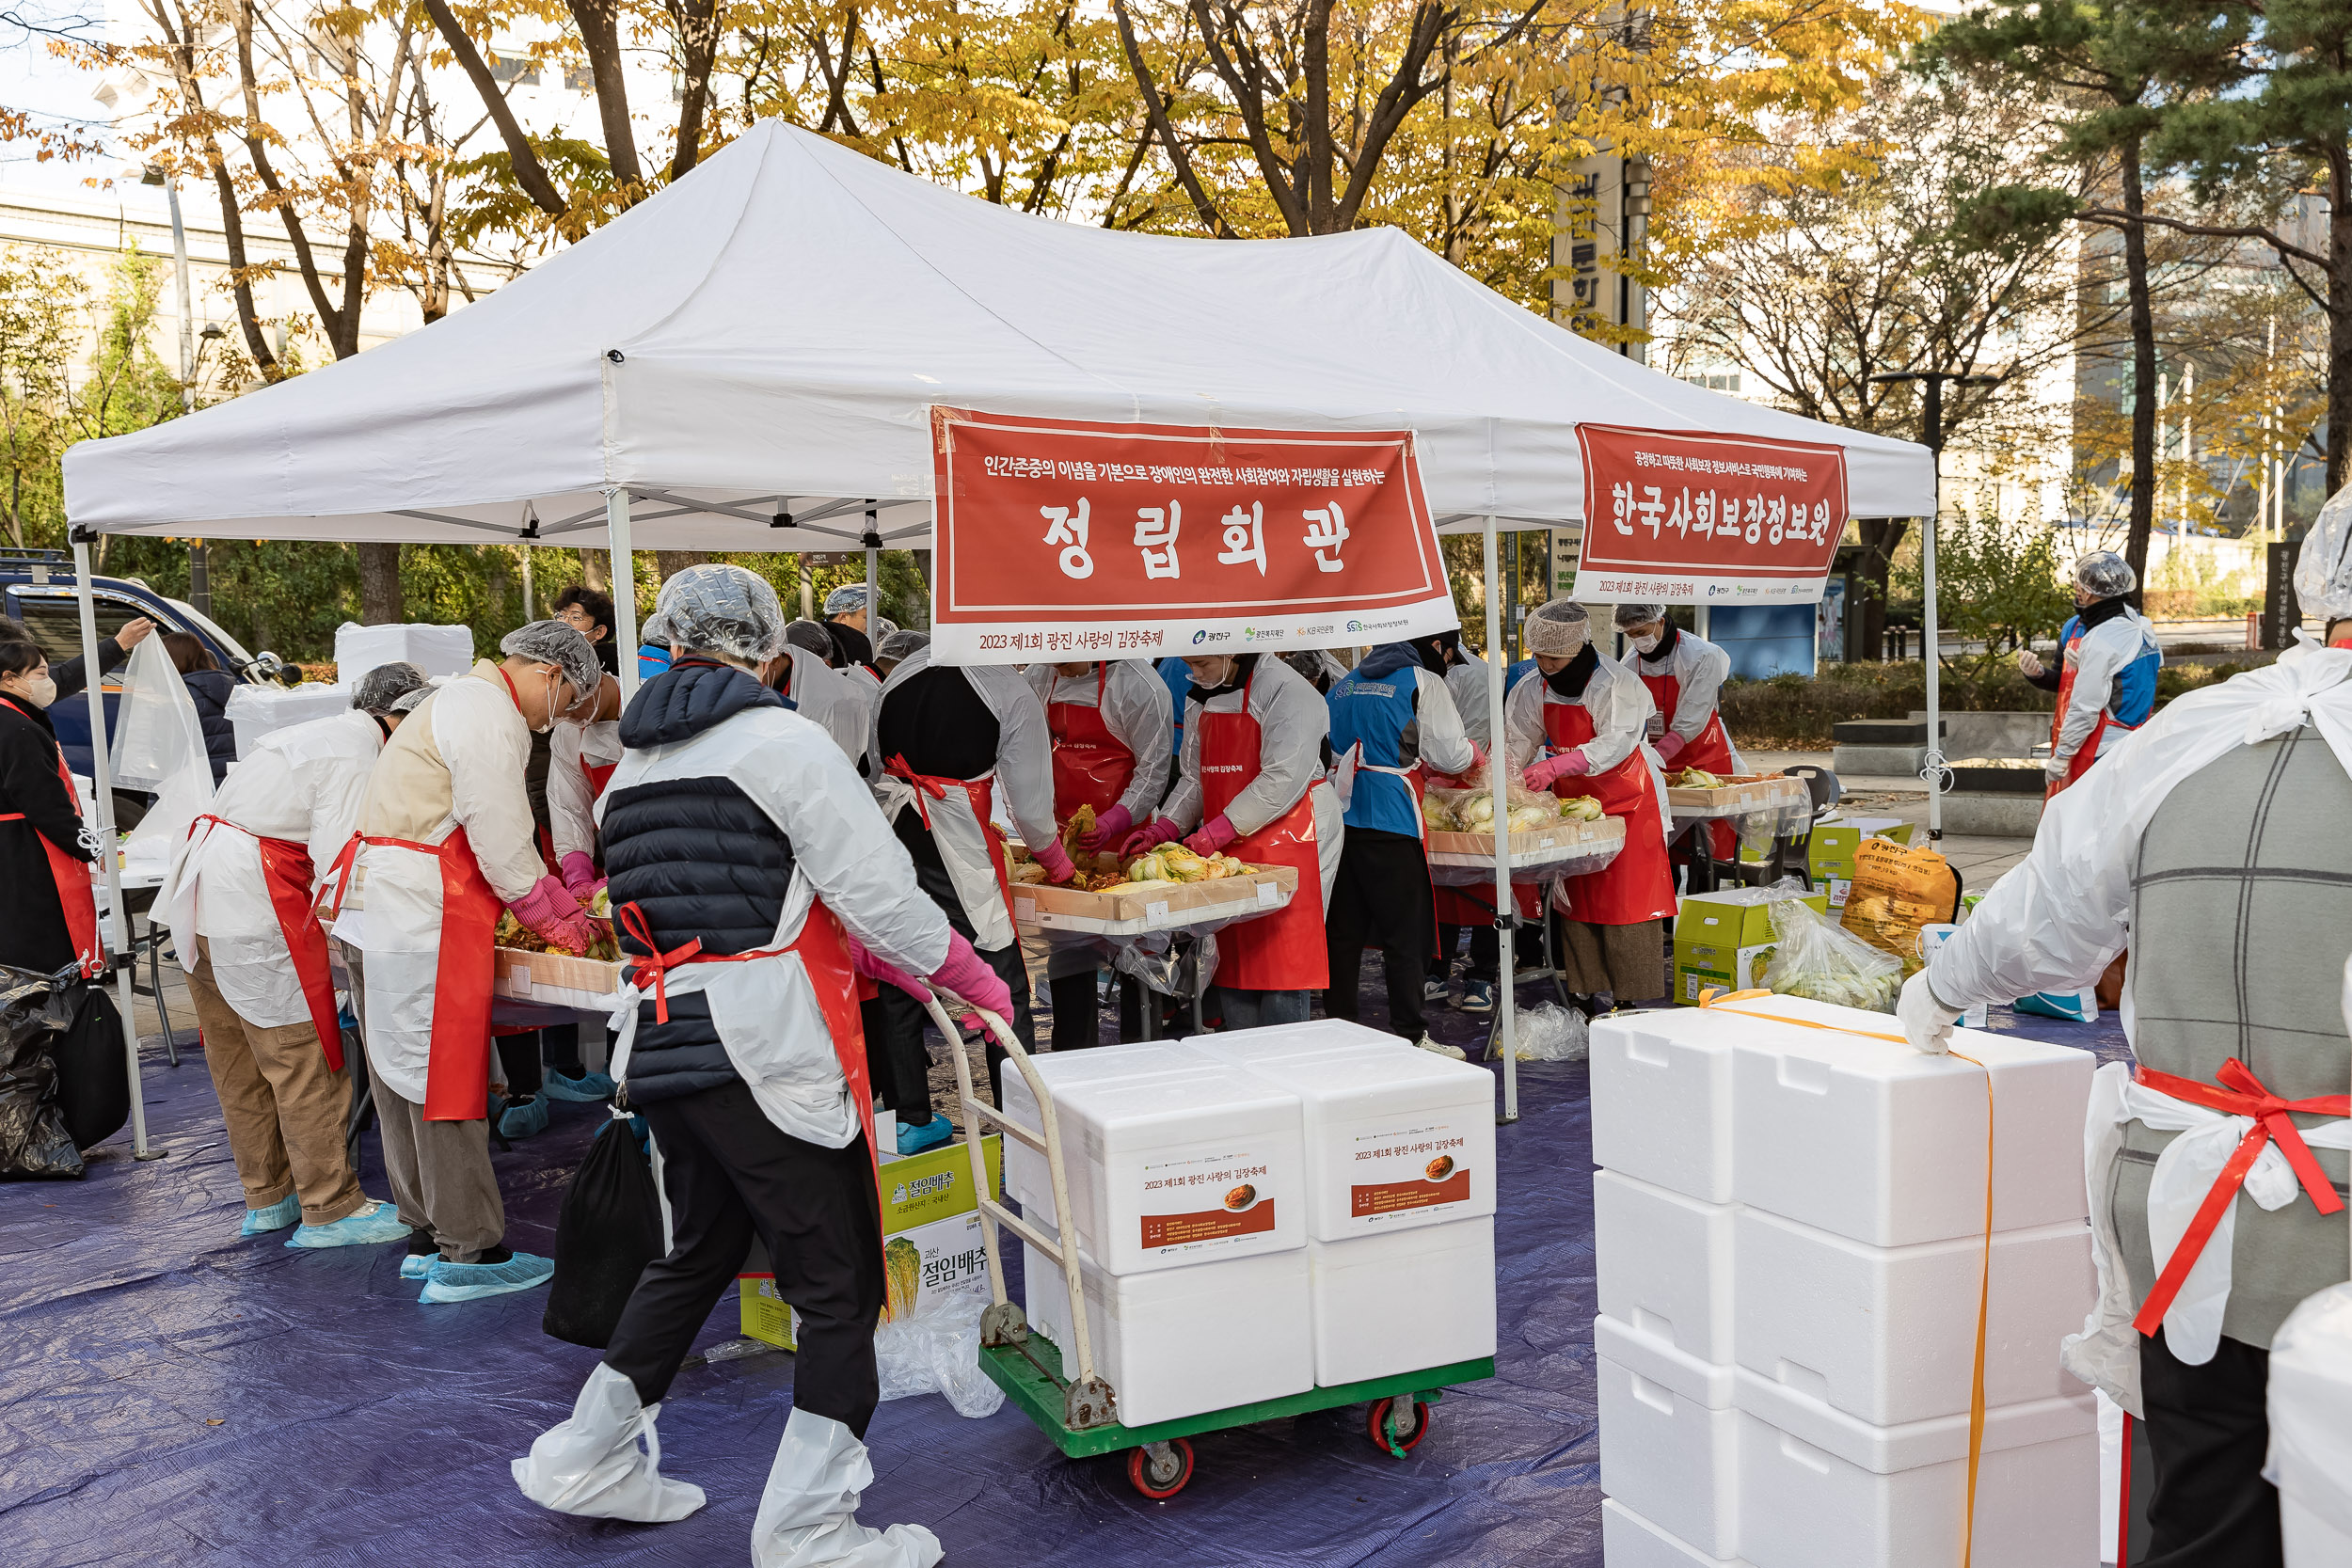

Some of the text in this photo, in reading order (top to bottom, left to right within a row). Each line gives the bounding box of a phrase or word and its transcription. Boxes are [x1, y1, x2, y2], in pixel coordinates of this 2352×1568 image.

[984, 455, 1386, 487] 인간존중의 이념을 기본으로 장애인의 완전한 사회참여와 자립생활을 실현하는
[1634, 451, 1808, 483] 공정하고 따뜻한 사회보장 정보서비스로 국민행복에 기여하는
[1612, 481, 1830, 546] 한국사회보장정보원
[1599, 580, 1693, 595] 2023 제1회 광진 사랑의 김장축제
[979, 629, 1164, 651] 2023 제1회 광진 사랑의 김장축제
[1208, 631, 1231, 641] 광진구
[1220, 765, 1243, 773] 김장축제
[1882, 844, 1908, 855] 광진구
[1355, 1137, 1464, 1160] 2023 제1회 광진 사랑의 김장축제
[909, 1171, 954, 1198] 절임배추
[1145, 1165, 1267, 1190] 2023 제1회 광진 사랑의 김장축제
[897, 1198, 926, 1214] 소금원산지
[932, 1194, 949, 1204] 국내산
[922, 1246, 988, 1288] 절임배추
